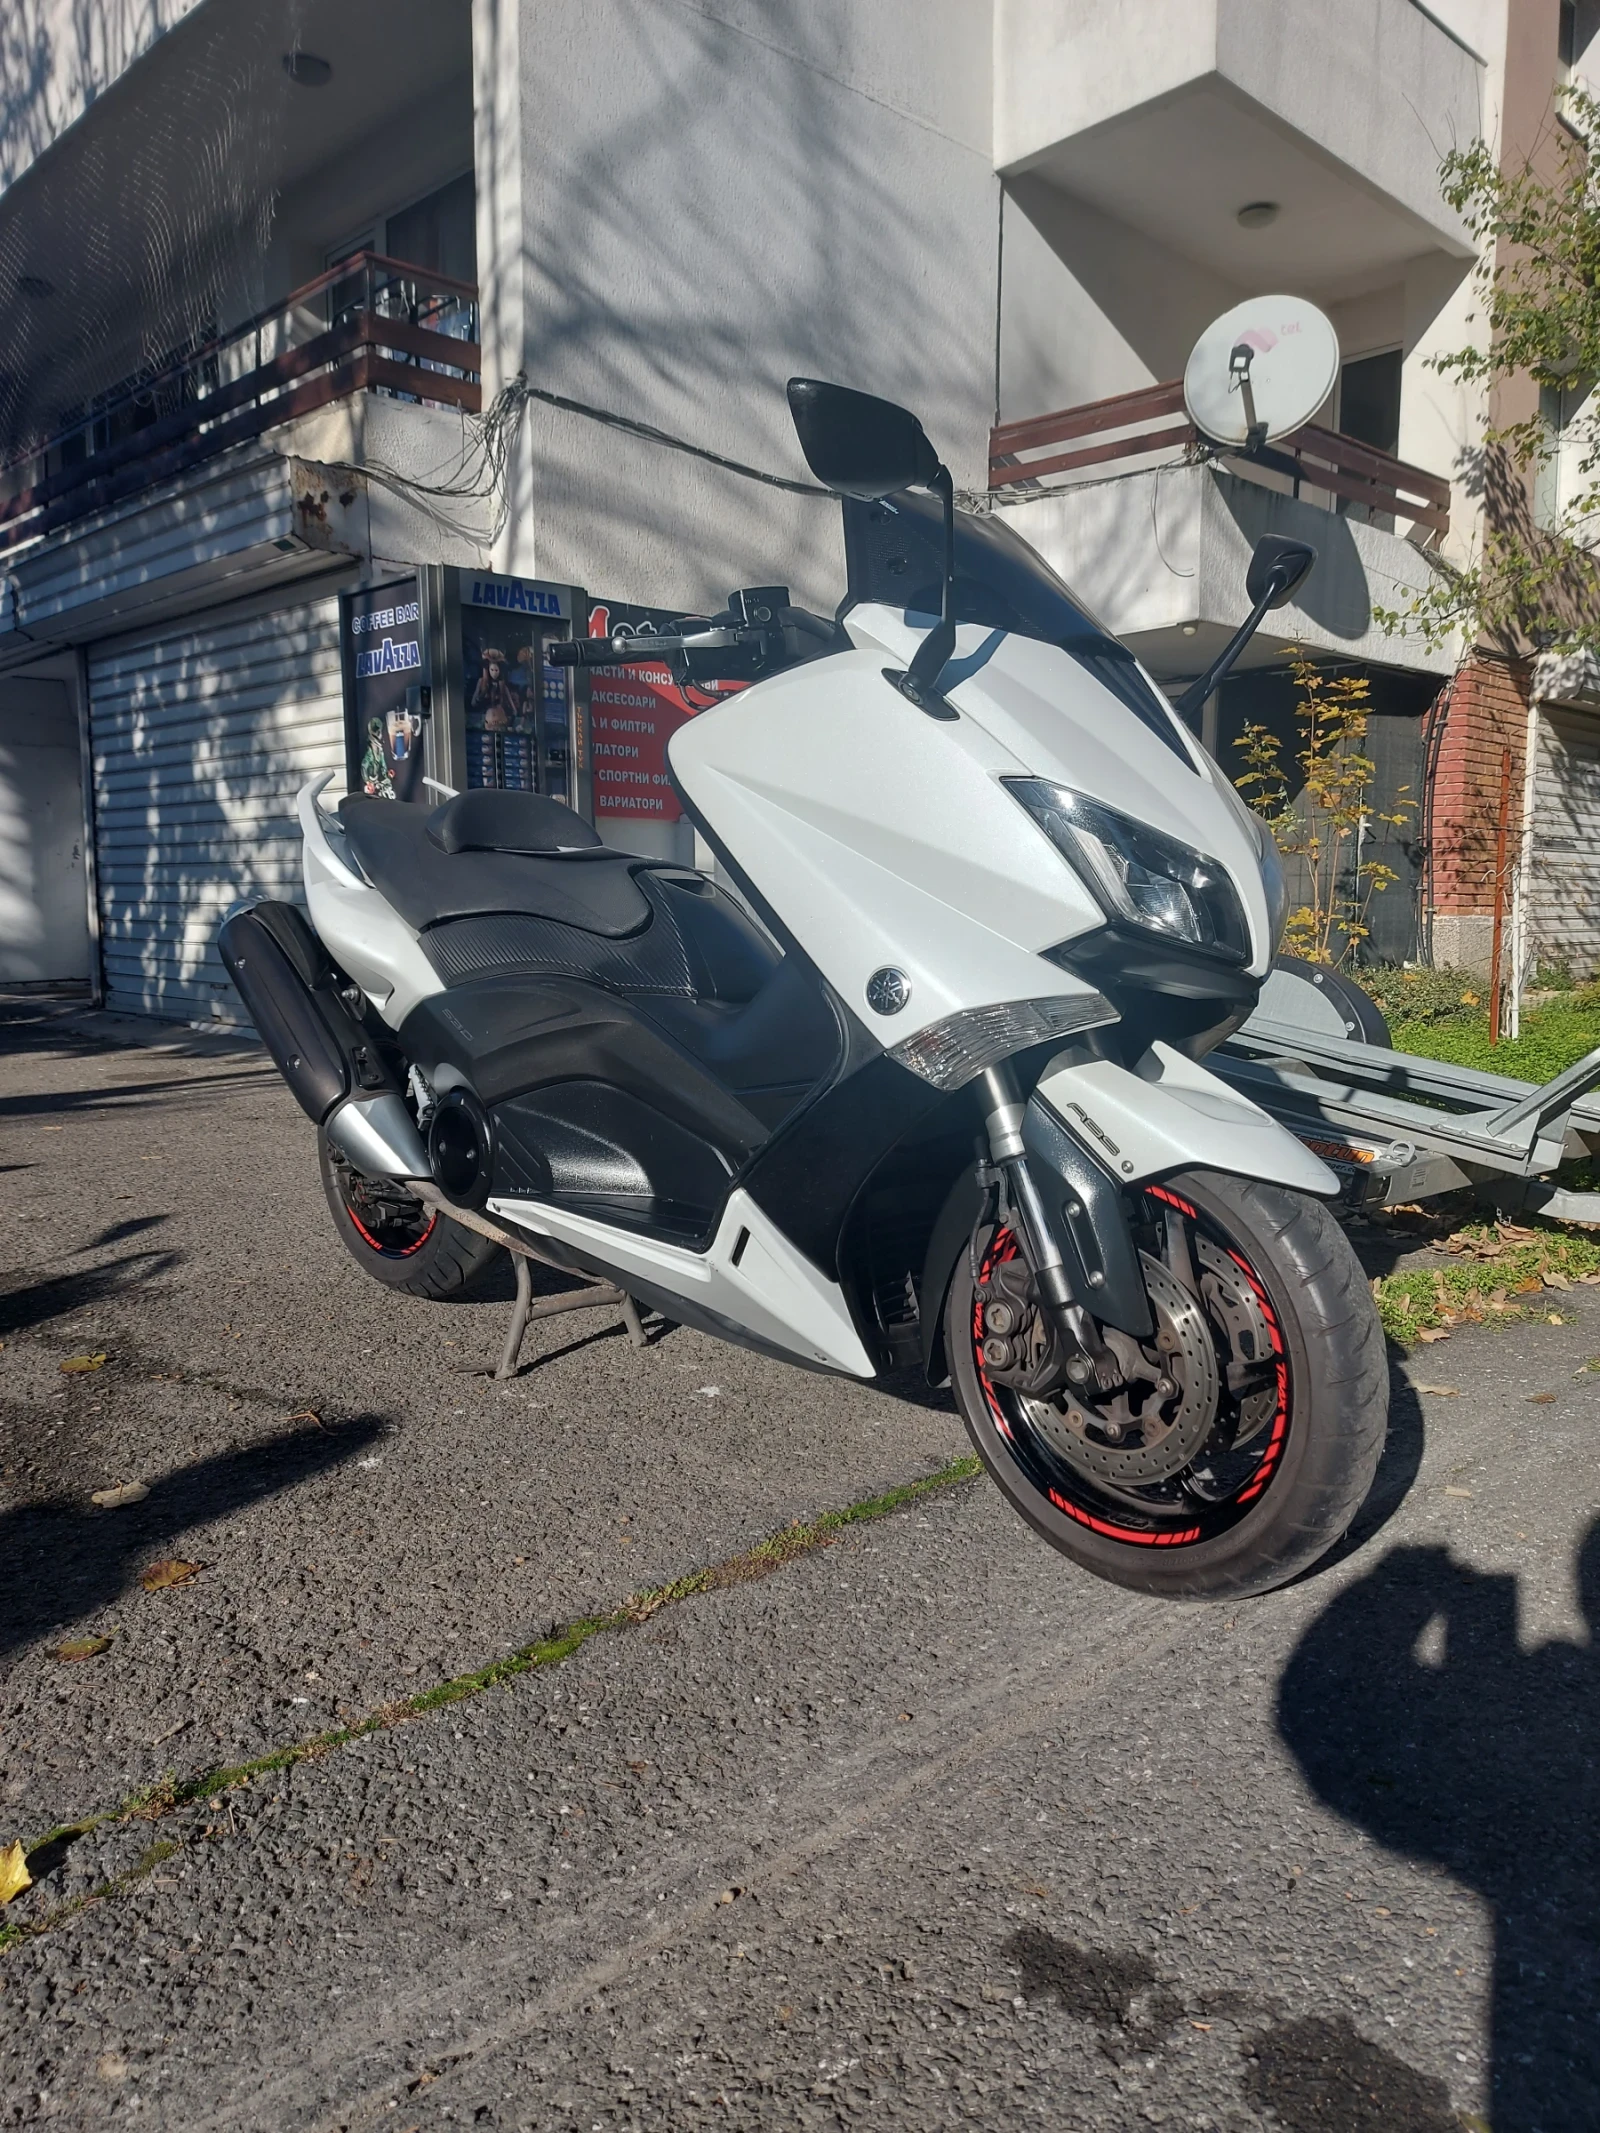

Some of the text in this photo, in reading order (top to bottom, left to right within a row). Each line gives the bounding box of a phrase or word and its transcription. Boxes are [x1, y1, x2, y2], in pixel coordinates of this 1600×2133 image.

[472, 580, 561, 616] LAVAZZA
[352, 602, 419, 634] COFFEE BAR
[356, 637, 421, 678] LAVAZZA
[628, 668, 636, 680] И
[591, 690, 656, 709] АКСЕСОАРИ
[600, 717, 608, 729] И
[611, 719, 655, 734] ФИЛТРИ
[592, 742, 639, 758] ЛАТОРИ
[598, 768, 671, 786] СПОРТНИ ФИ
[600, 795, 663, 810] ВАРИАТОРИ
[1066, 1103, 1120, 1156] ABS
[1300, 1138, 1375, 1164] ptun
